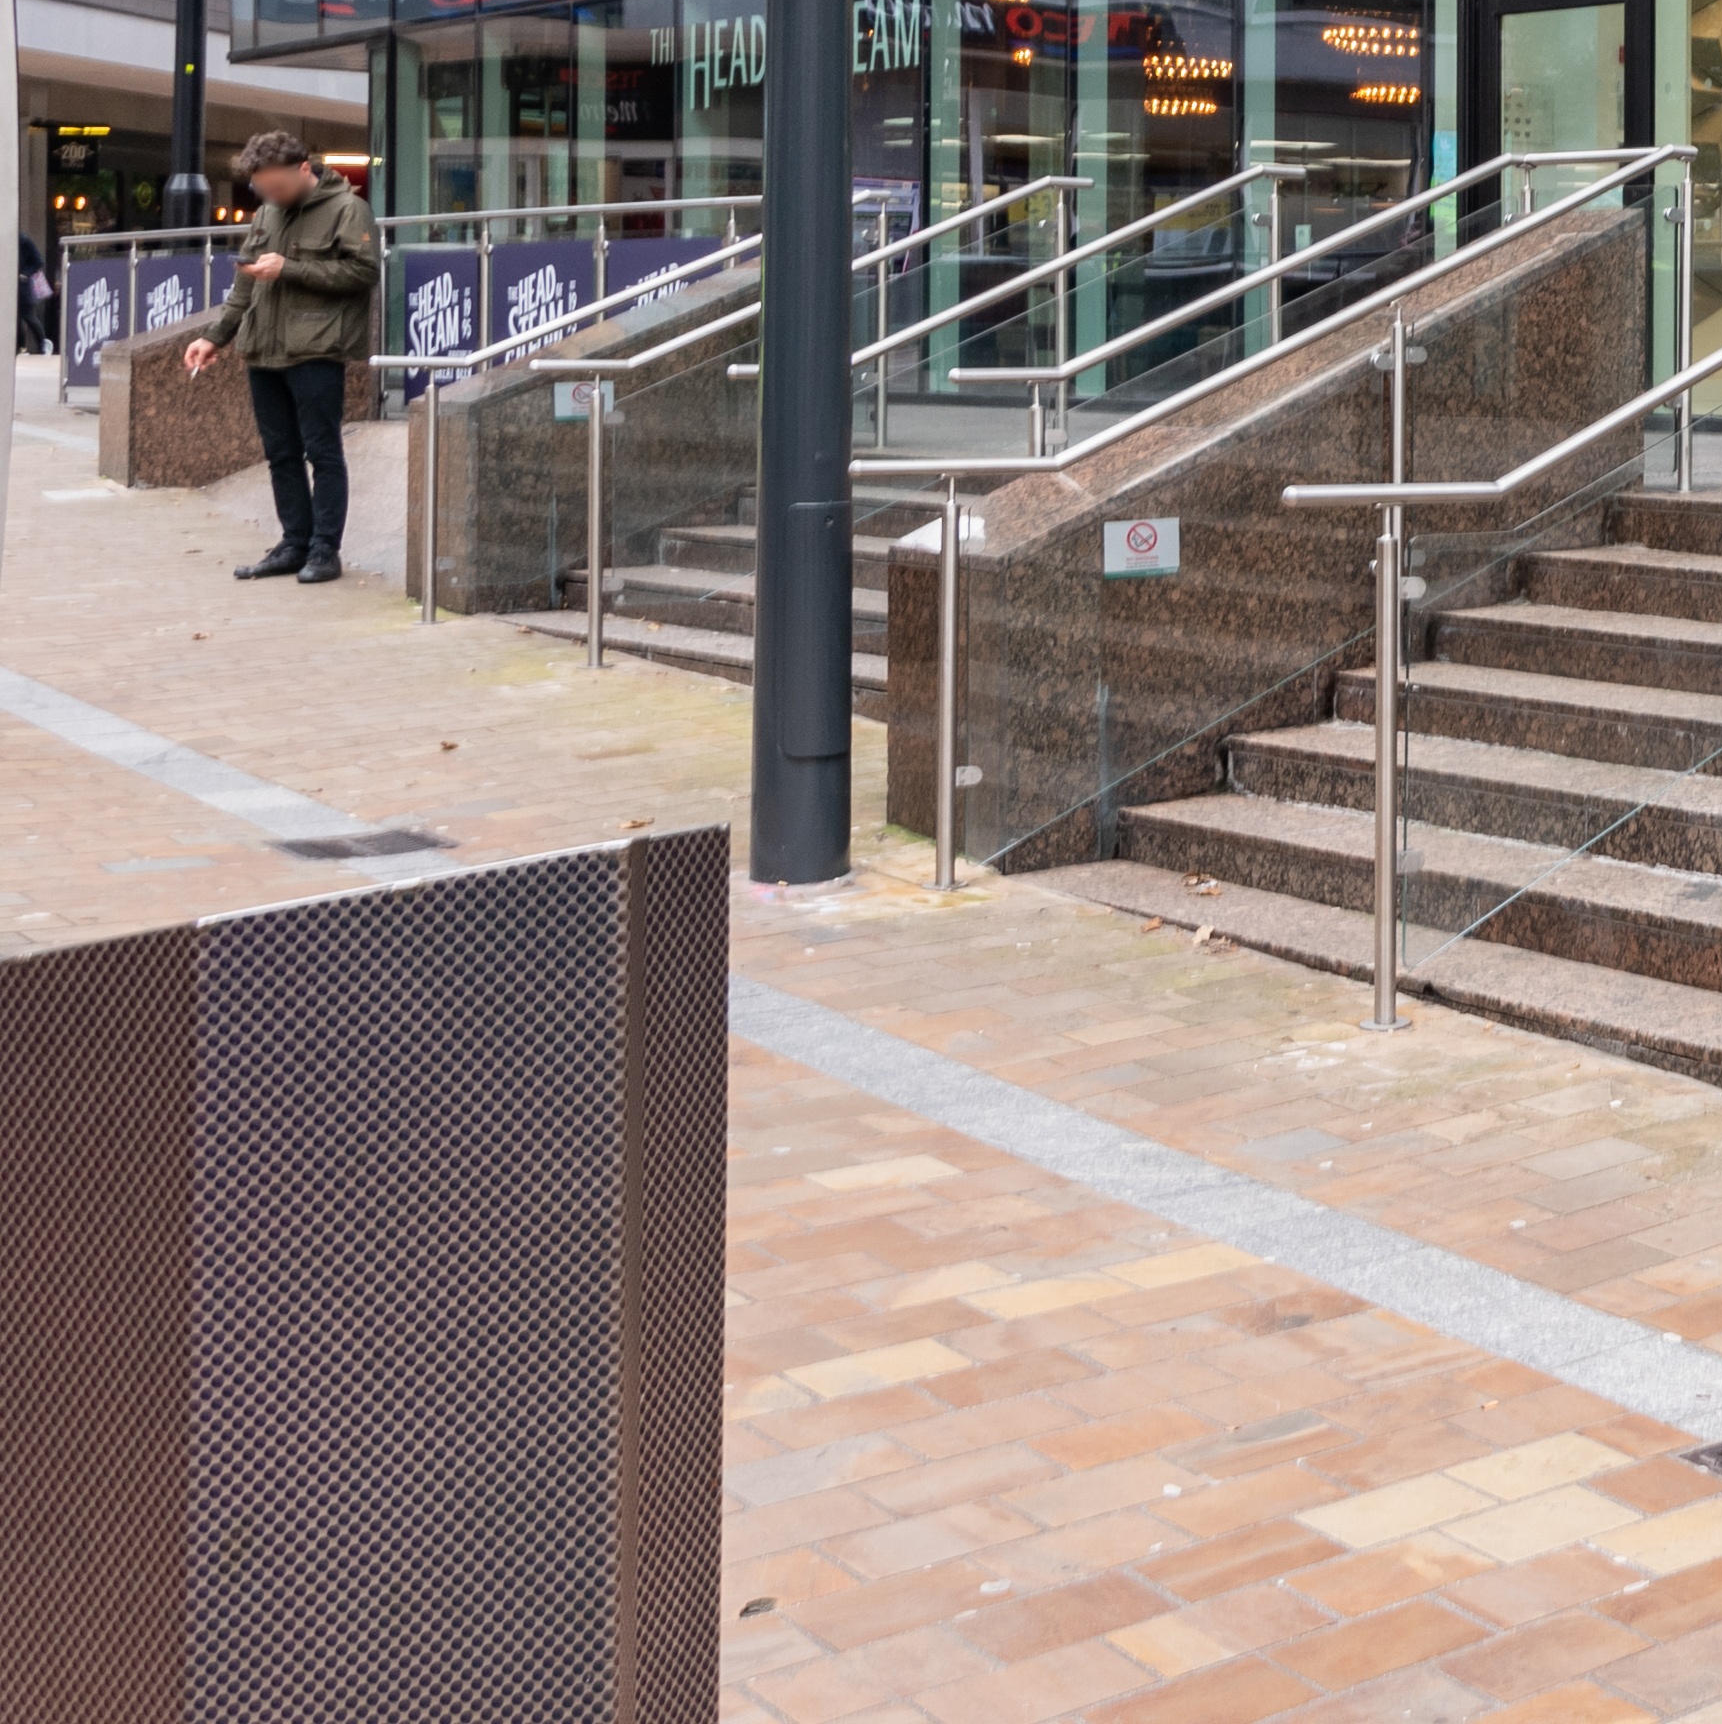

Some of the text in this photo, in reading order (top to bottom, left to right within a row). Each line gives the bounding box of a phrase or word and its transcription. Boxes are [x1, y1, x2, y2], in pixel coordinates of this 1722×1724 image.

[690, 14, 766, 112] HEAD
[418, 272, 452, 321] HEAD
[518, 264, 556, 315] HEAD
